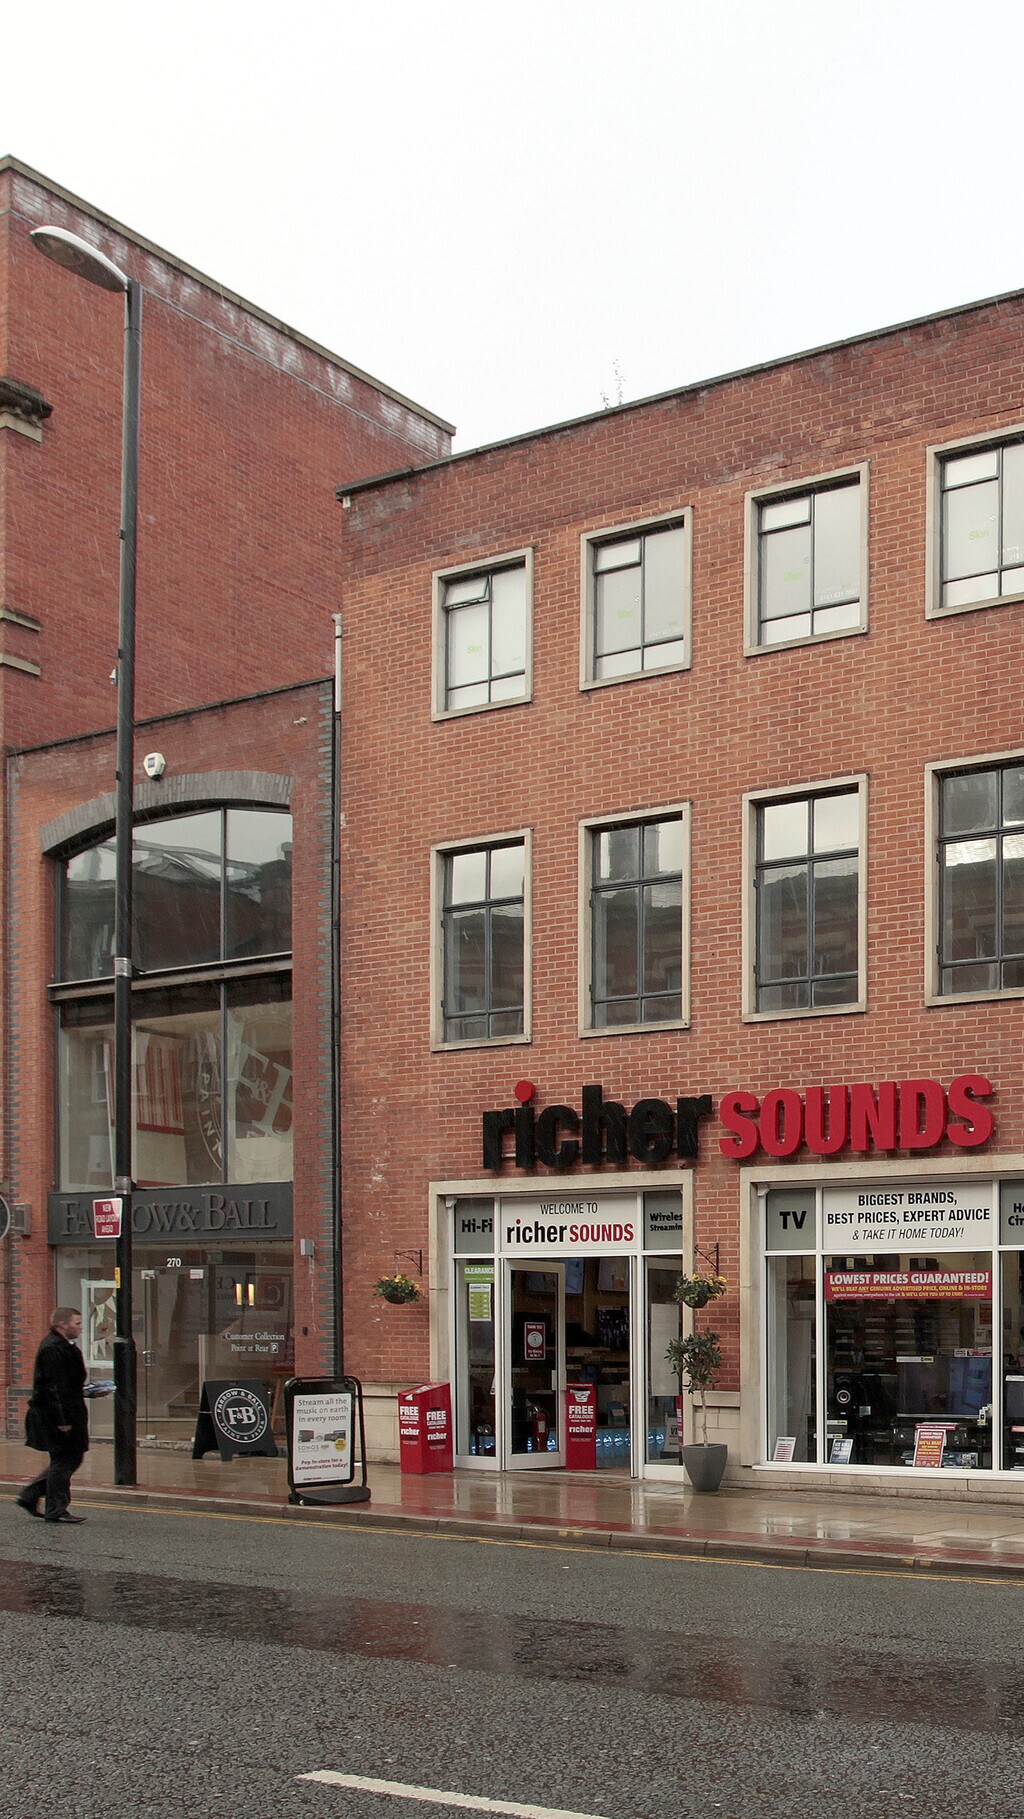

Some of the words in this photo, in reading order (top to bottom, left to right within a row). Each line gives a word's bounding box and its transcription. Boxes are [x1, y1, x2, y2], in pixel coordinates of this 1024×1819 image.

[483, 1080, 712, 1170] richer
[719, 1075, 996, 1159] SOUNDS
[858, 1194, 904, 1206] BIGGEST
[908, 1192, 957, 1206] BRANDS,
[540, 1203, 584, 1215] WELCOME
[586, 1202, 598, 1213] TO
[60, 1201, 178, 1236] FAOW
[201, 1193, 277, 1230] BALL
[650, 1212, 683, 1221] Wireles
[827, 1213, 854, 1224] BEST
[857, 1211, 899, 1225] PRICES,
[903, 1210, 945, 1222] EXPERT
[948, 1208, 990, 1221] ADVICE
[780, 1211, 806, 1229] TV
[461, 1218, 493, 1233] Hi-Fi
[650, 1223, 683, 1231] Streamin
[506, 1219, 567, 1243] richer
[569, 1223, 634, 1242] SOUNDS
[852, 1229, 859, 1240] &
[862, 1229, 885, 1240] TAKE
[887, 1228, 897, 1239] IT
[899, 1228, 927, 1239] HOME
[930, 1227, 965, 1239] TODAY!
[166, 1257, 181, 1268] 270
[464, 1267, 494, 1275] CLEARANCE
[829, 1274, 870, 1285] LOWEST
[873, 1273, 908, 1285] PRICES
[911, 1272, 989, 1284] GUARANTEED!
[225, 1332, 253, 1340] Customer
[255, 1331, 285, 1340] Collection
[231, 1343, 246, 1351] Point
[255, 1344, 269, 1352] Rear
[217, 1390, 238, 1413] FARROW
[247, 1394, 262, 1411] BALL
[325, 1397, 334, 1405] all
[335, 1397, 347, 1405] the
[330, 1405, 349, 1413] earth
[400, 1406, 419, 1415] FREE
[569, 1405, 594, 1414] FREE
[226, 1406, 256, 1425] F&B
[307, 1415, 327, 1423] every
[427, 1411, 446, 1420] FREE
[400, 1427, 419, 1435] richer
[428, 1432, 447, 1440] richer
